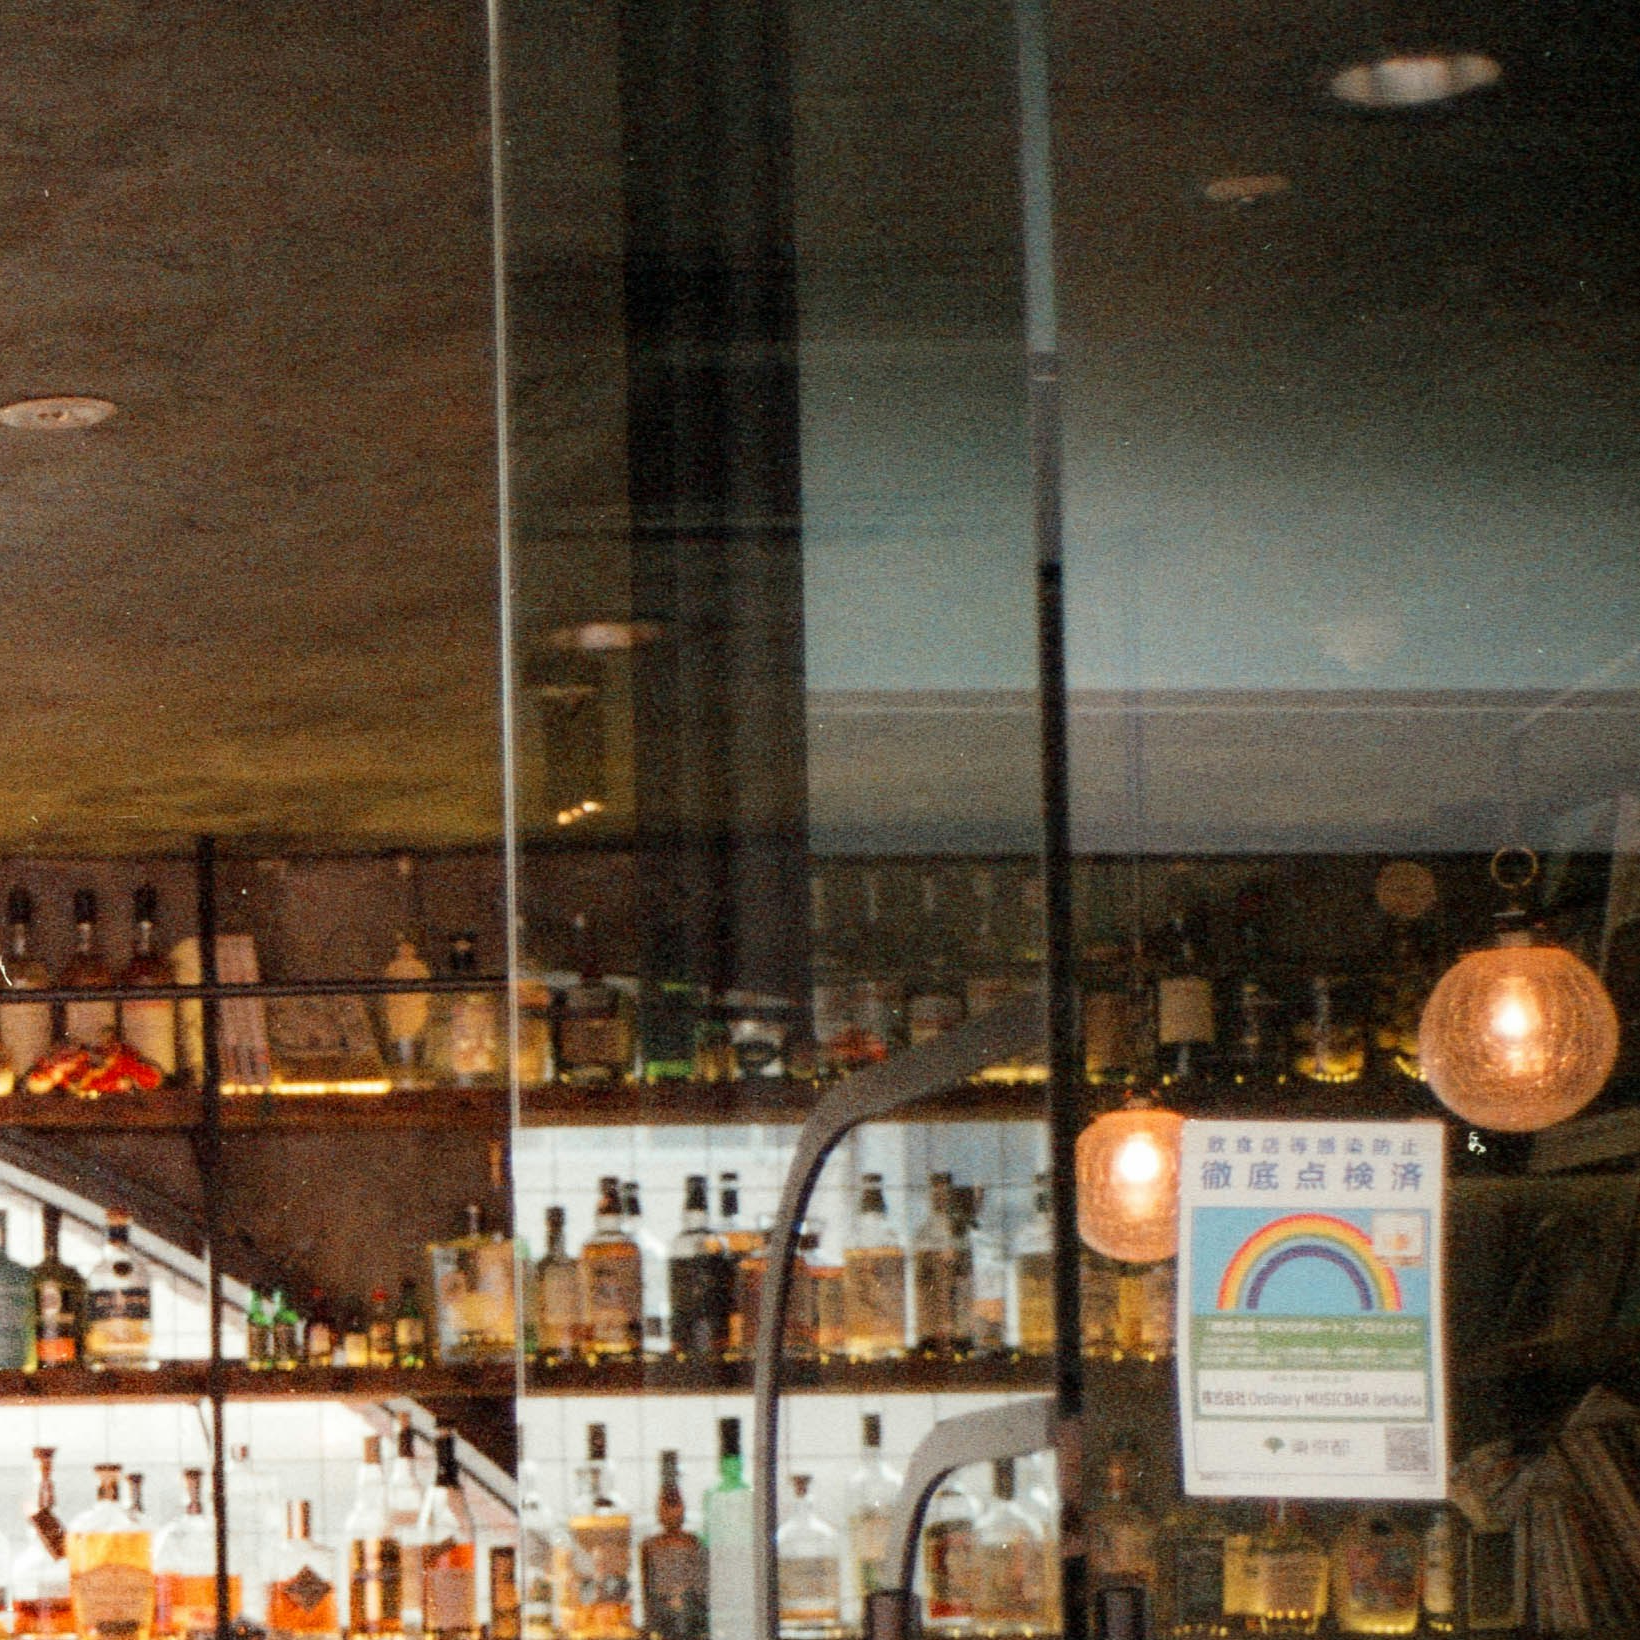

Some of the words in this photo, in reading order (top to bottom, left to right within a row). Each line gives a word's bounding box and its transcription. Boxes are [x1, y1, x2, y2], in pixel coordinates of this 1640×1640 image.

[1201, 1160, 1423, 1192] 徹底点検済
